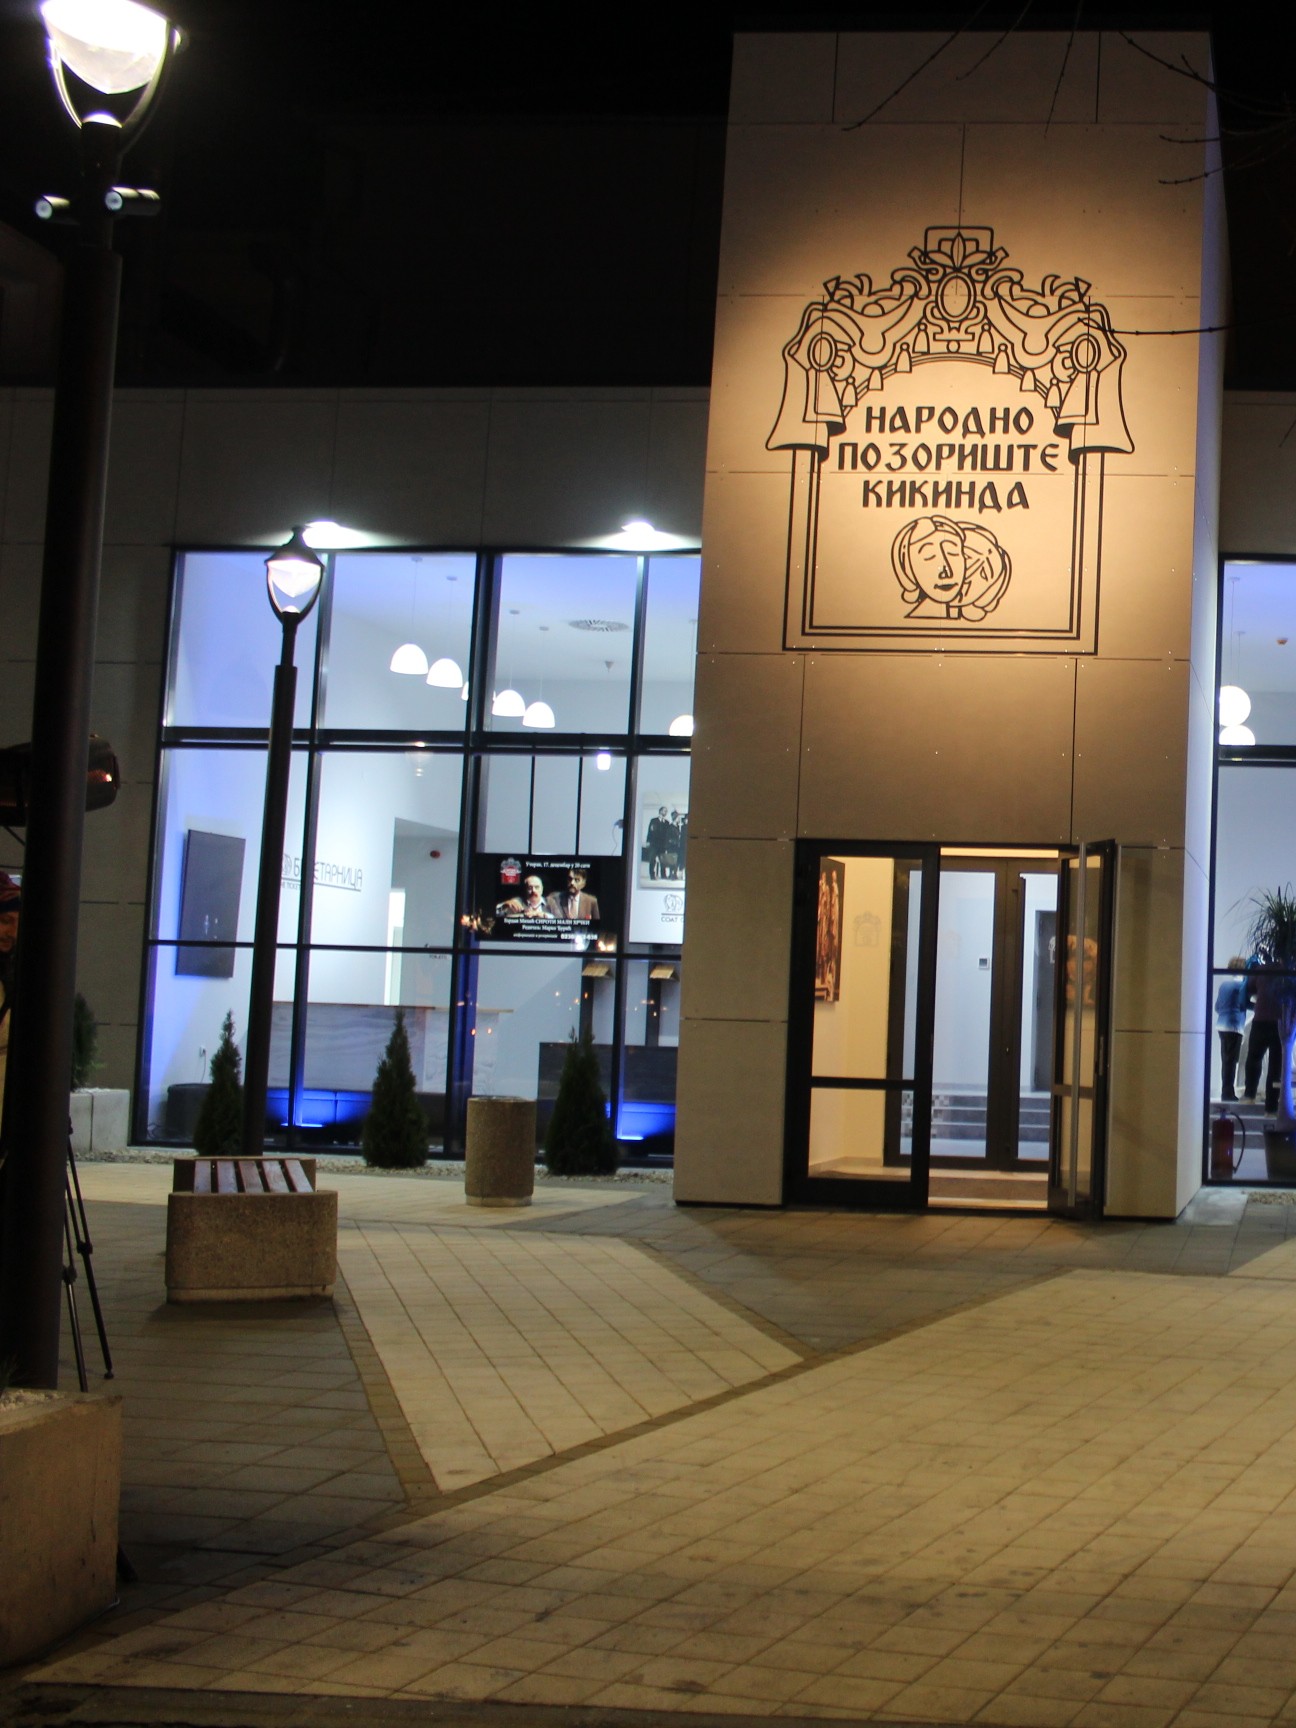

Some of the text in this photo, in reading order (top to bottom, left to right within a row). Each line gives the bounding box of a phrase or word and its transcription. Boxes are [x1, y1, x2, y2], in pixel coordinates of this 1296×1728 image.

[865, 406, 1034, 439] НАРОДНО
[838, 442, 1060, 472] ПОЗОРИШТЕ
[862, 480, 1030, 514] КИКИНДА
[293, 857, 363, 890] БЕТАРНИЦА
